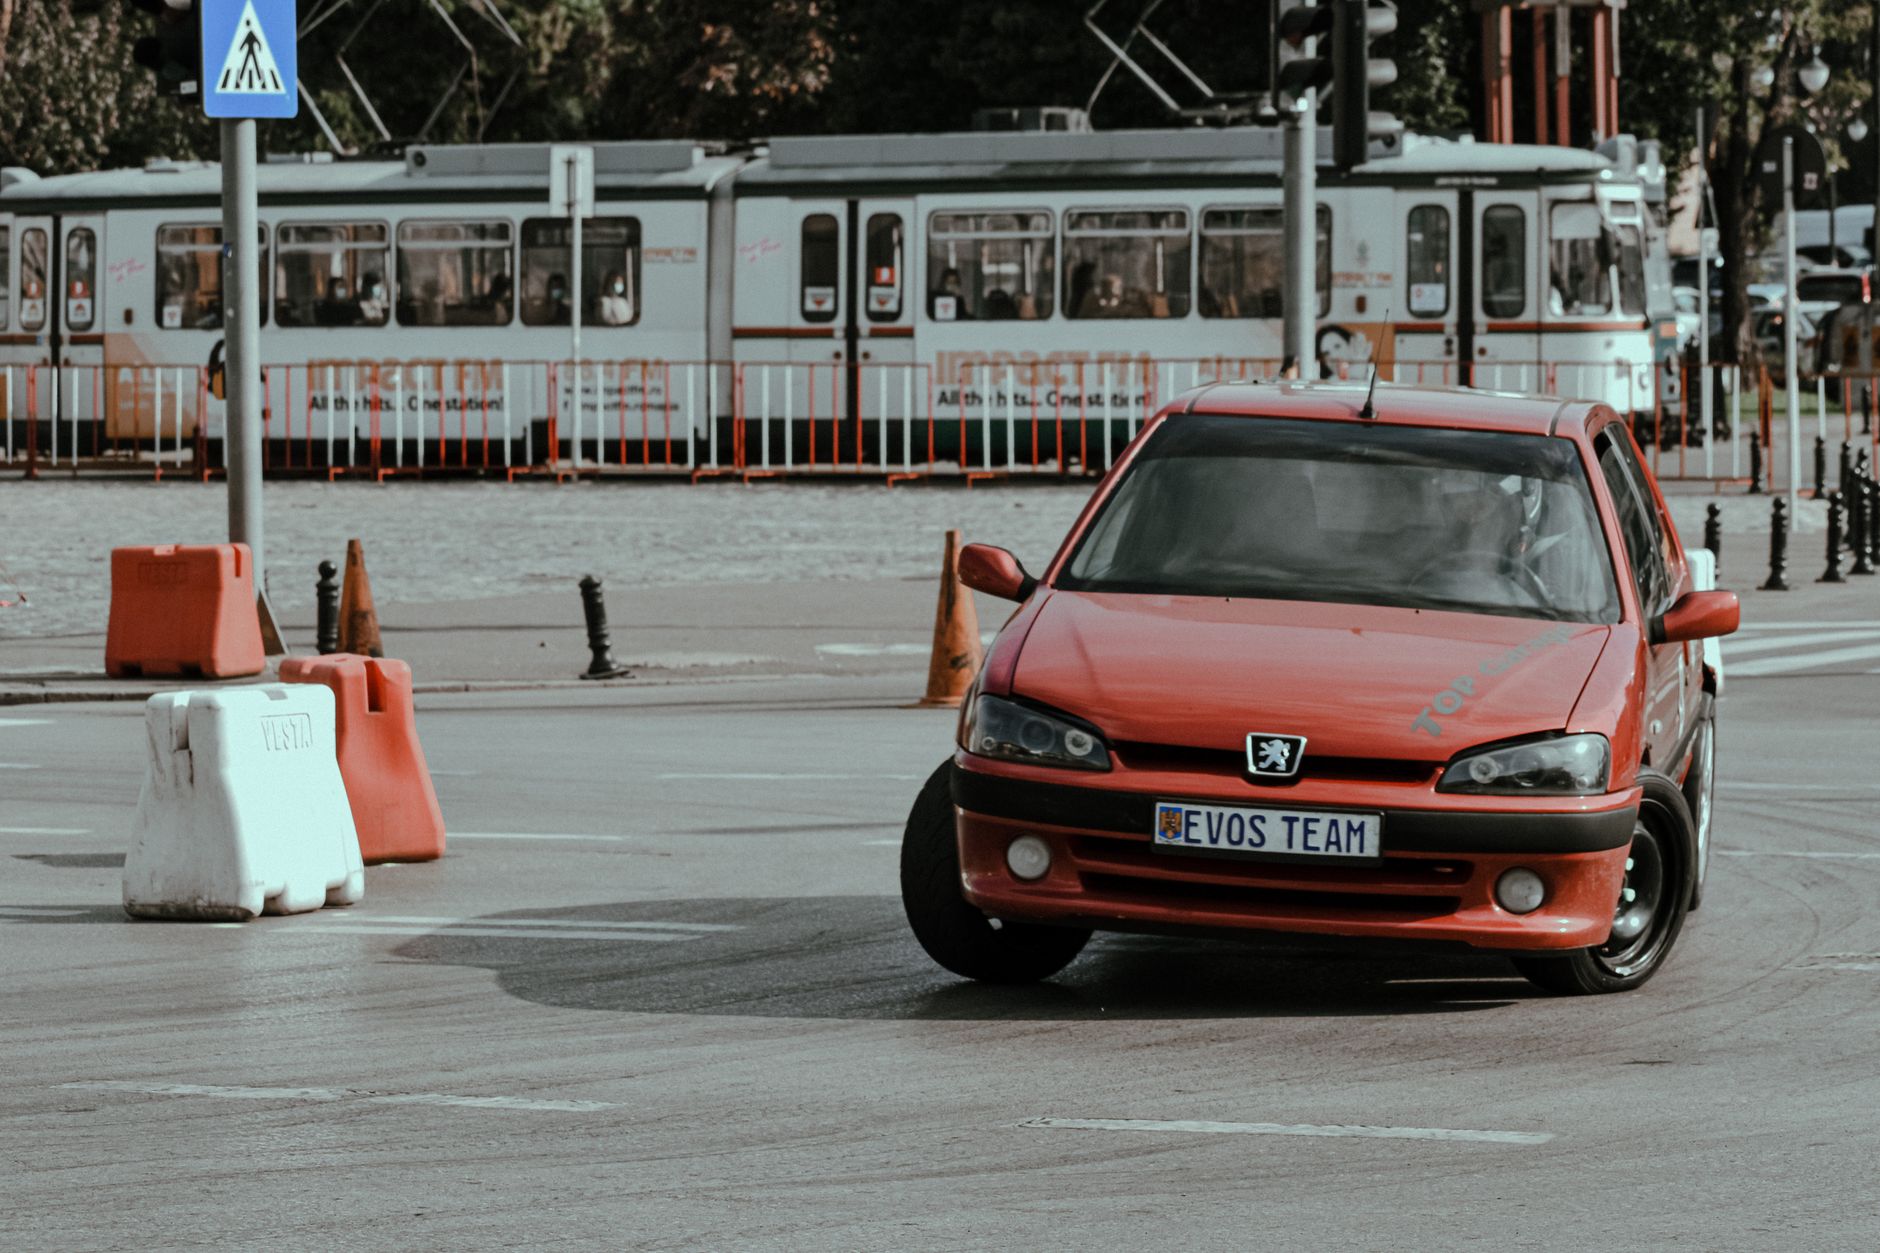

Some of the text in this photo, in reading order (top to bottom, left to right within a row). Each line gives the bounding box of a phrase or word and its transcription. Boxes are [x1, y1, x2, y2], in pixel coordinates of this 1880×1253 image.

[363, 396, 405, 412] hts...
[407, 396, 441, 412] One
[964, 390, 992, 406] th
[996, 390, 1042, 407] hts...
[1046, 390, 1081, 407] One
[1410, 674, 1477, 737] TOP
[1184, 809, 1366, 854] EVOS TEAM
